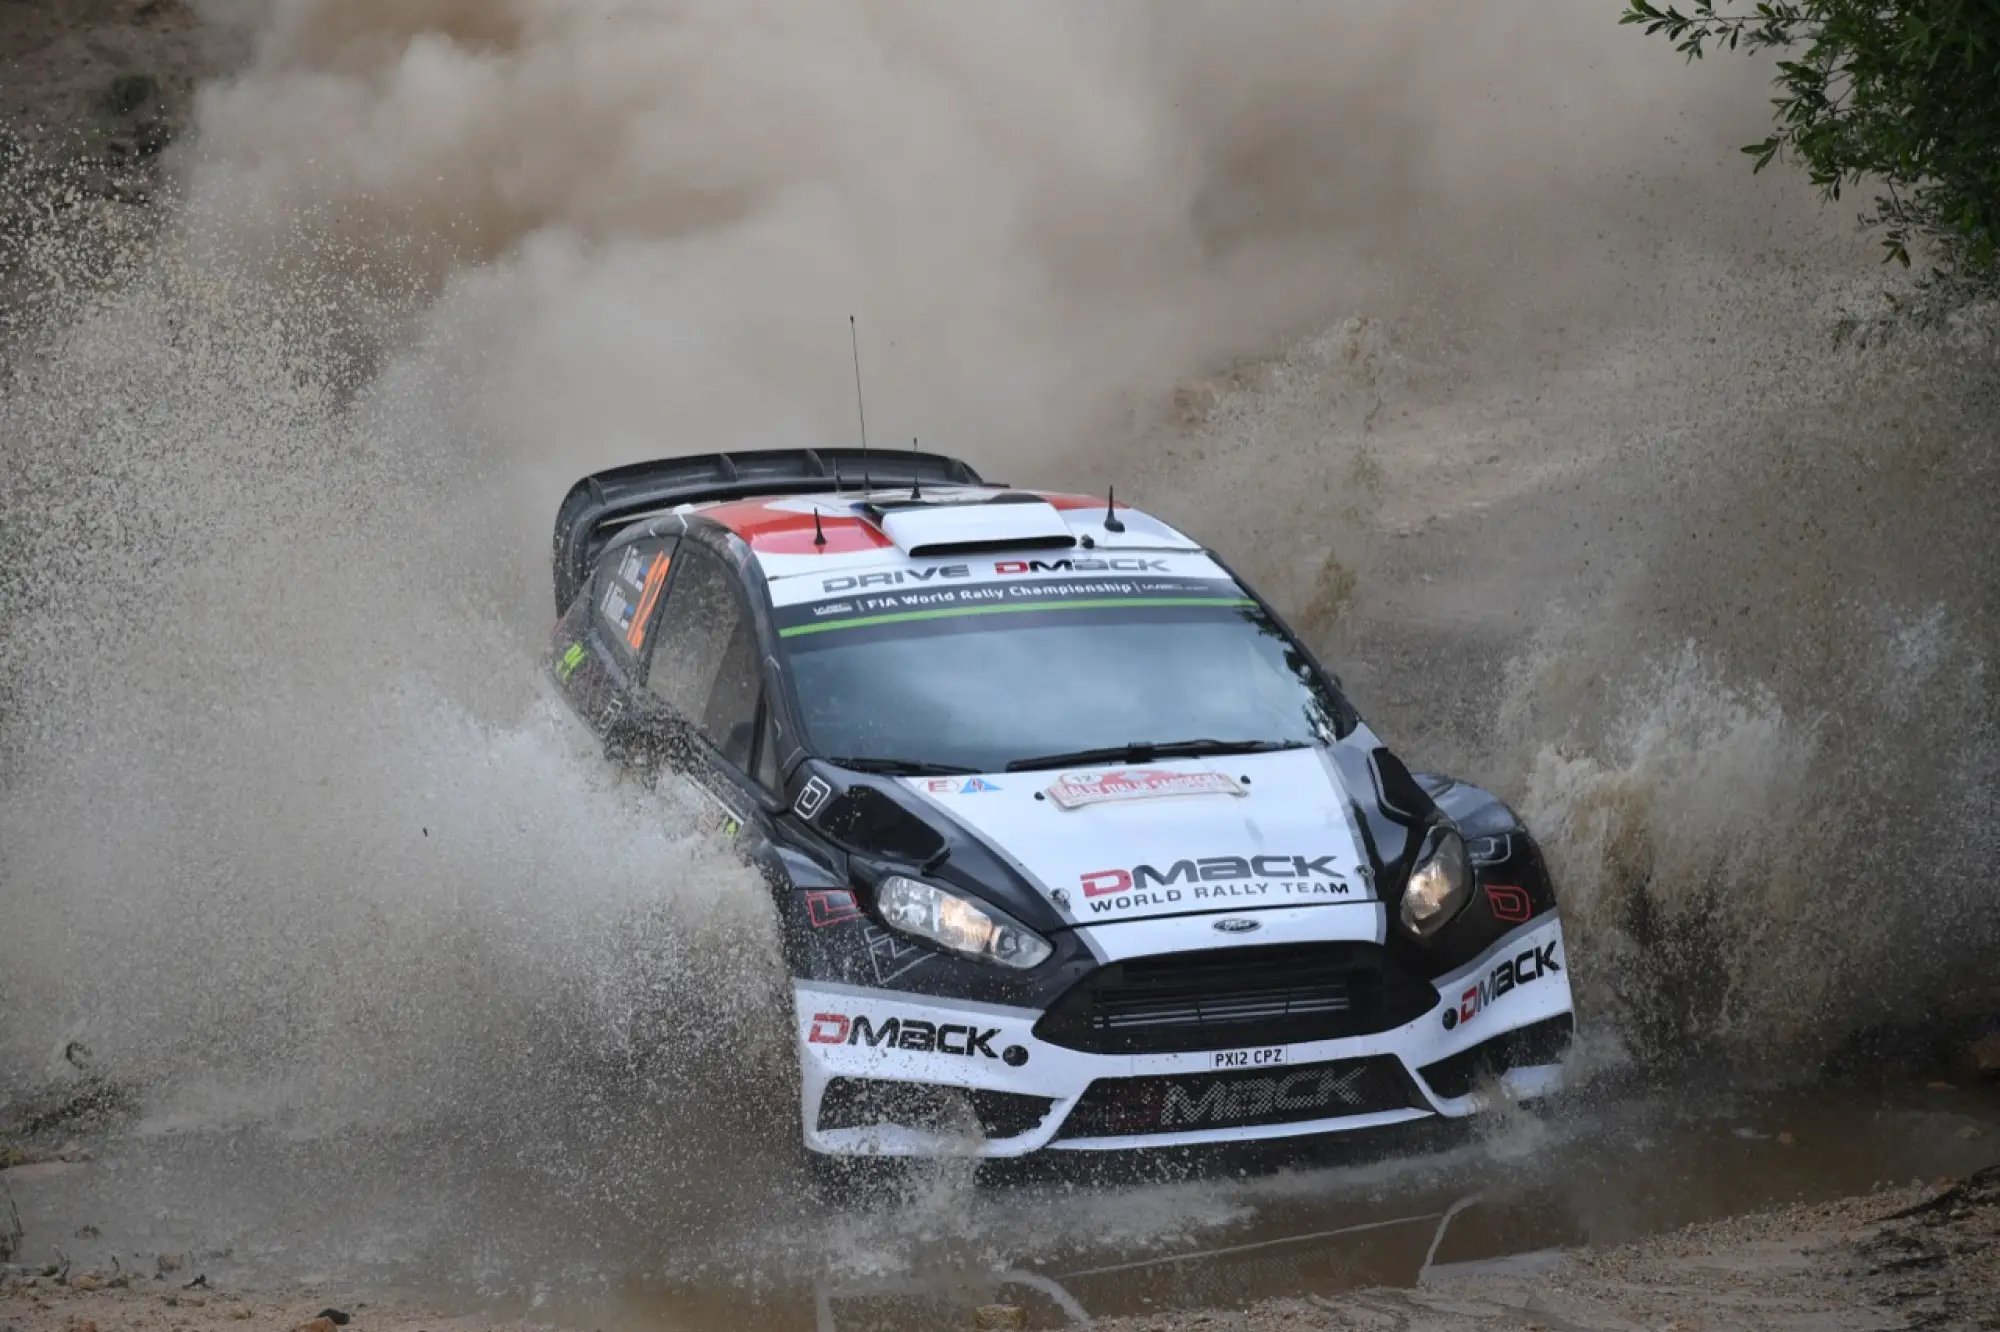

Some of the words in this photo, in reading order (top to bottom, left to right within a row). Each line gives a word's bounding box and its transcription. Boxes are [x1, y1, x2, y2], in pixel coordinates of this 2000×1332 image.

[822, 564, 970, 593] DRIVE
[994, 558, 1172, 574] DMACK
[866, 599, 899, 610] FIA
[902, 591, 954, 605] World
[960, 587, 1004, 600] Rally
[1010, 581, 1132, 597] Championship
[1079, 854, 1346, 899] DMACK
[1089, 889, 1182, 913] WORLD
[1195, 881, 1270, 900] RALLY
[1280, 880, 1350, 897] TEAM
[1459, 939, 1561, 1025] DMACK
[808, 1012, 1003, 1060] DMACK
[1214, 1052, 1249, 1067] PX12
[1252, 1049, 1283, 1064] CPZ
